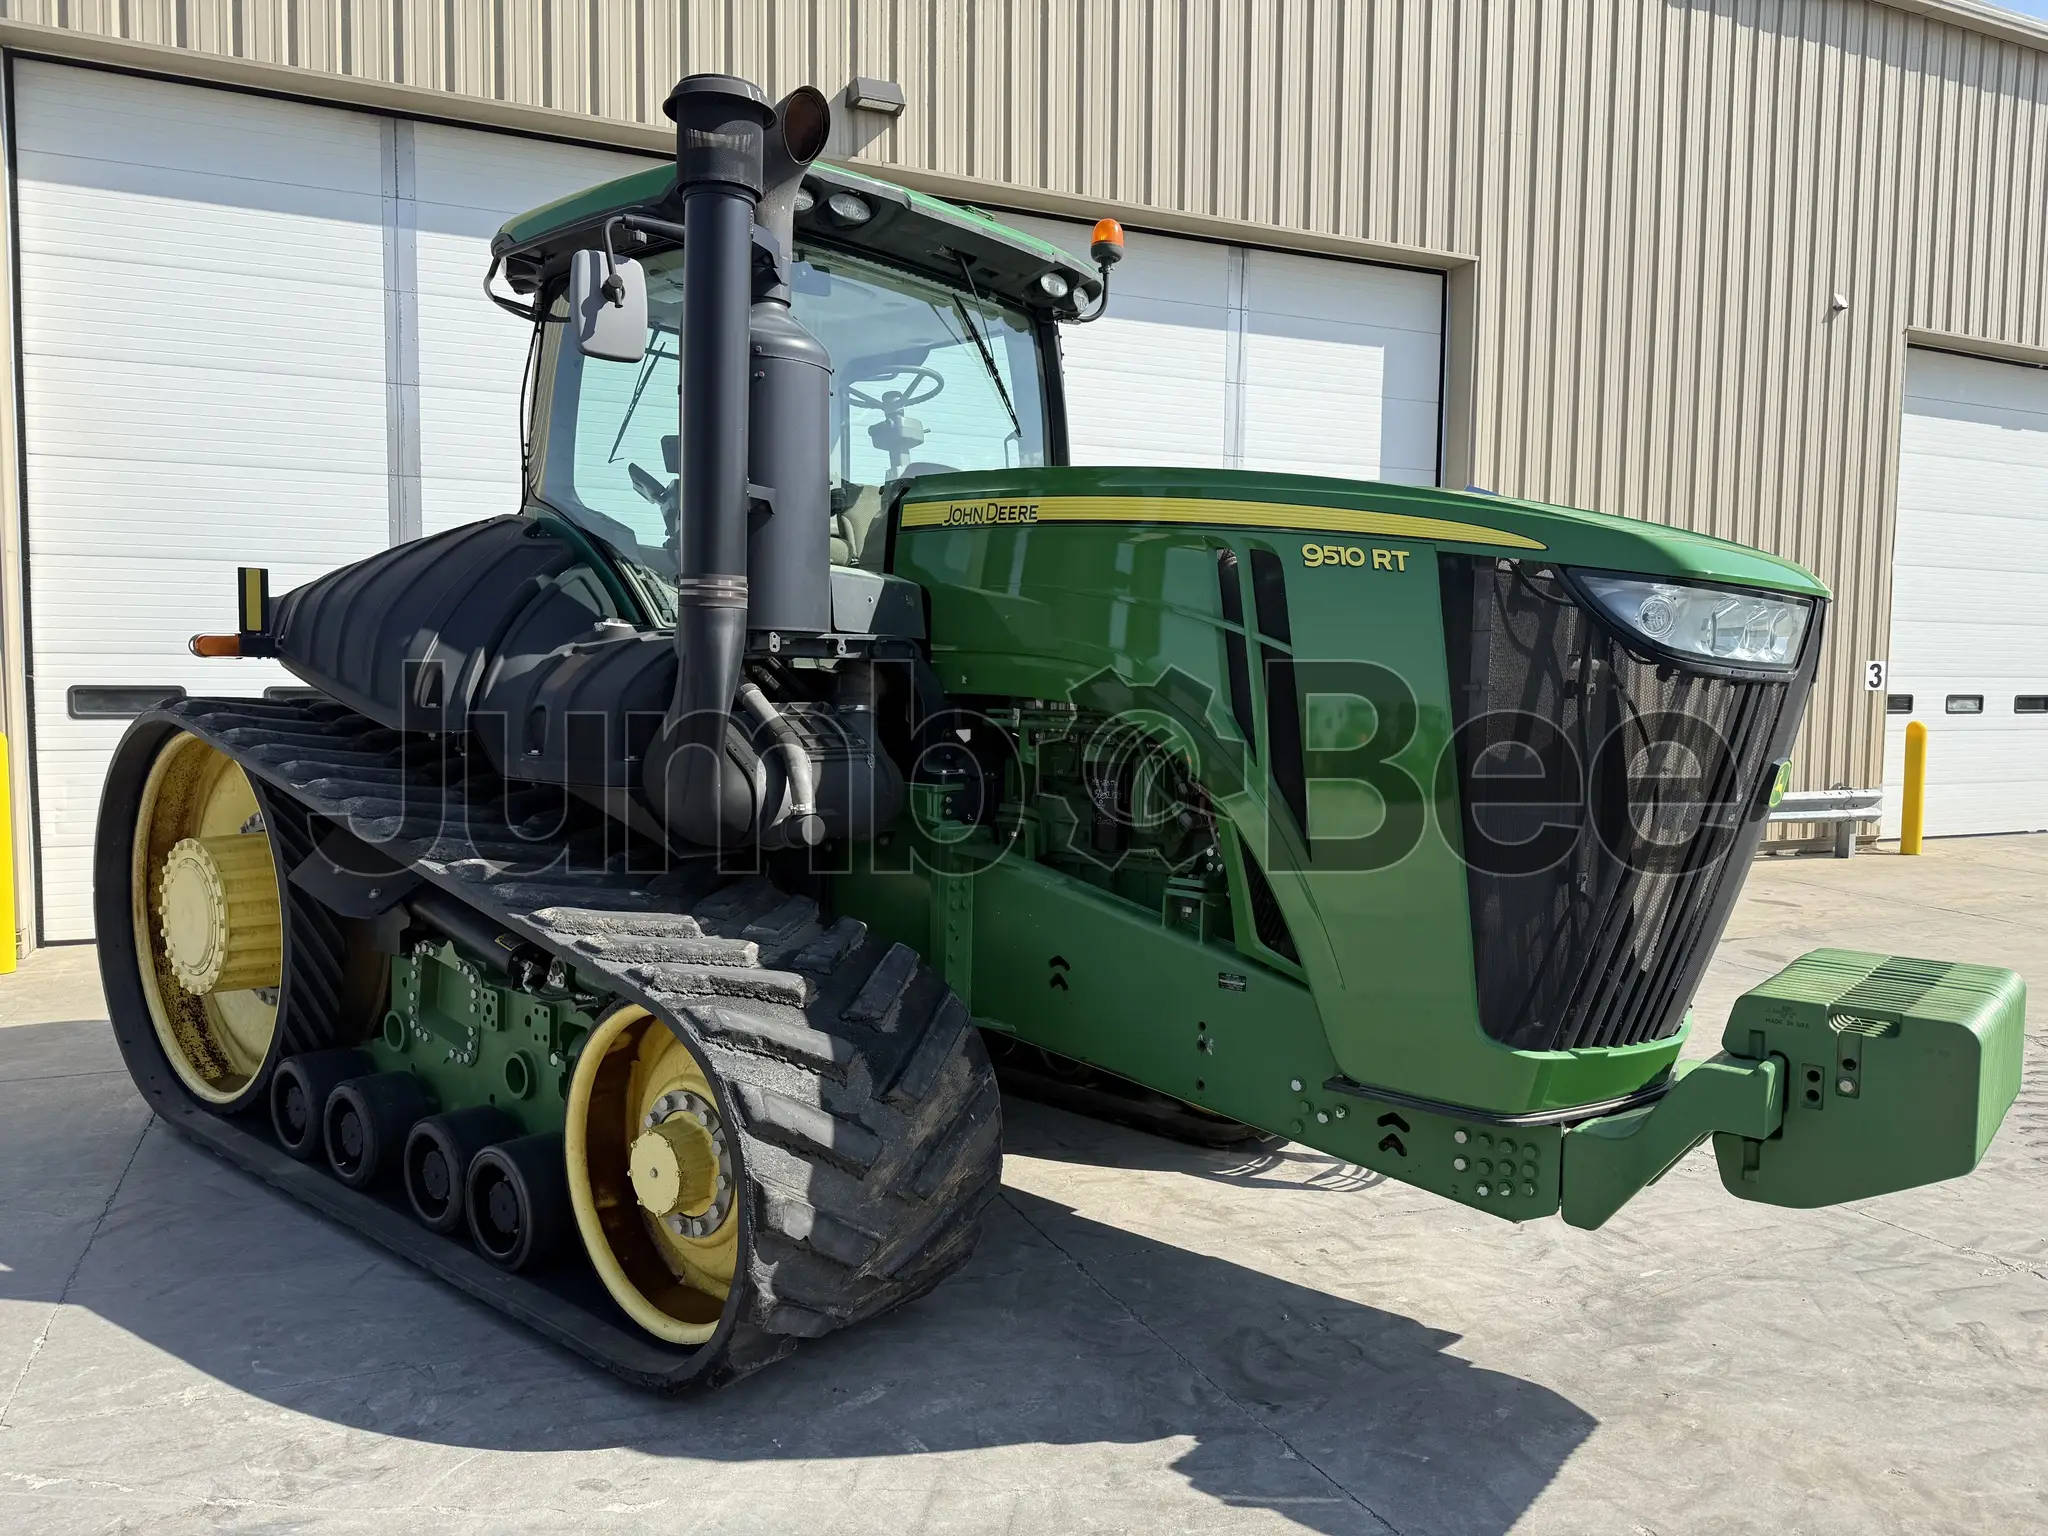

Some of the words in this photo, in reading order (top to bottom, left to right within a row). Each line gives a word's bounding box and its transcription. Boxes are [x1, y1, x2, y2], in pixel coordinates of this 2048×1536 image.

[943, 504, 984, 523] JOHN
[986, 502, 1039, 521] DEERE
[1301, 543, 1366, 568] 9510
[1371, 548, 1410, 572] RT
[1869, 663, 1882, 688] 3
